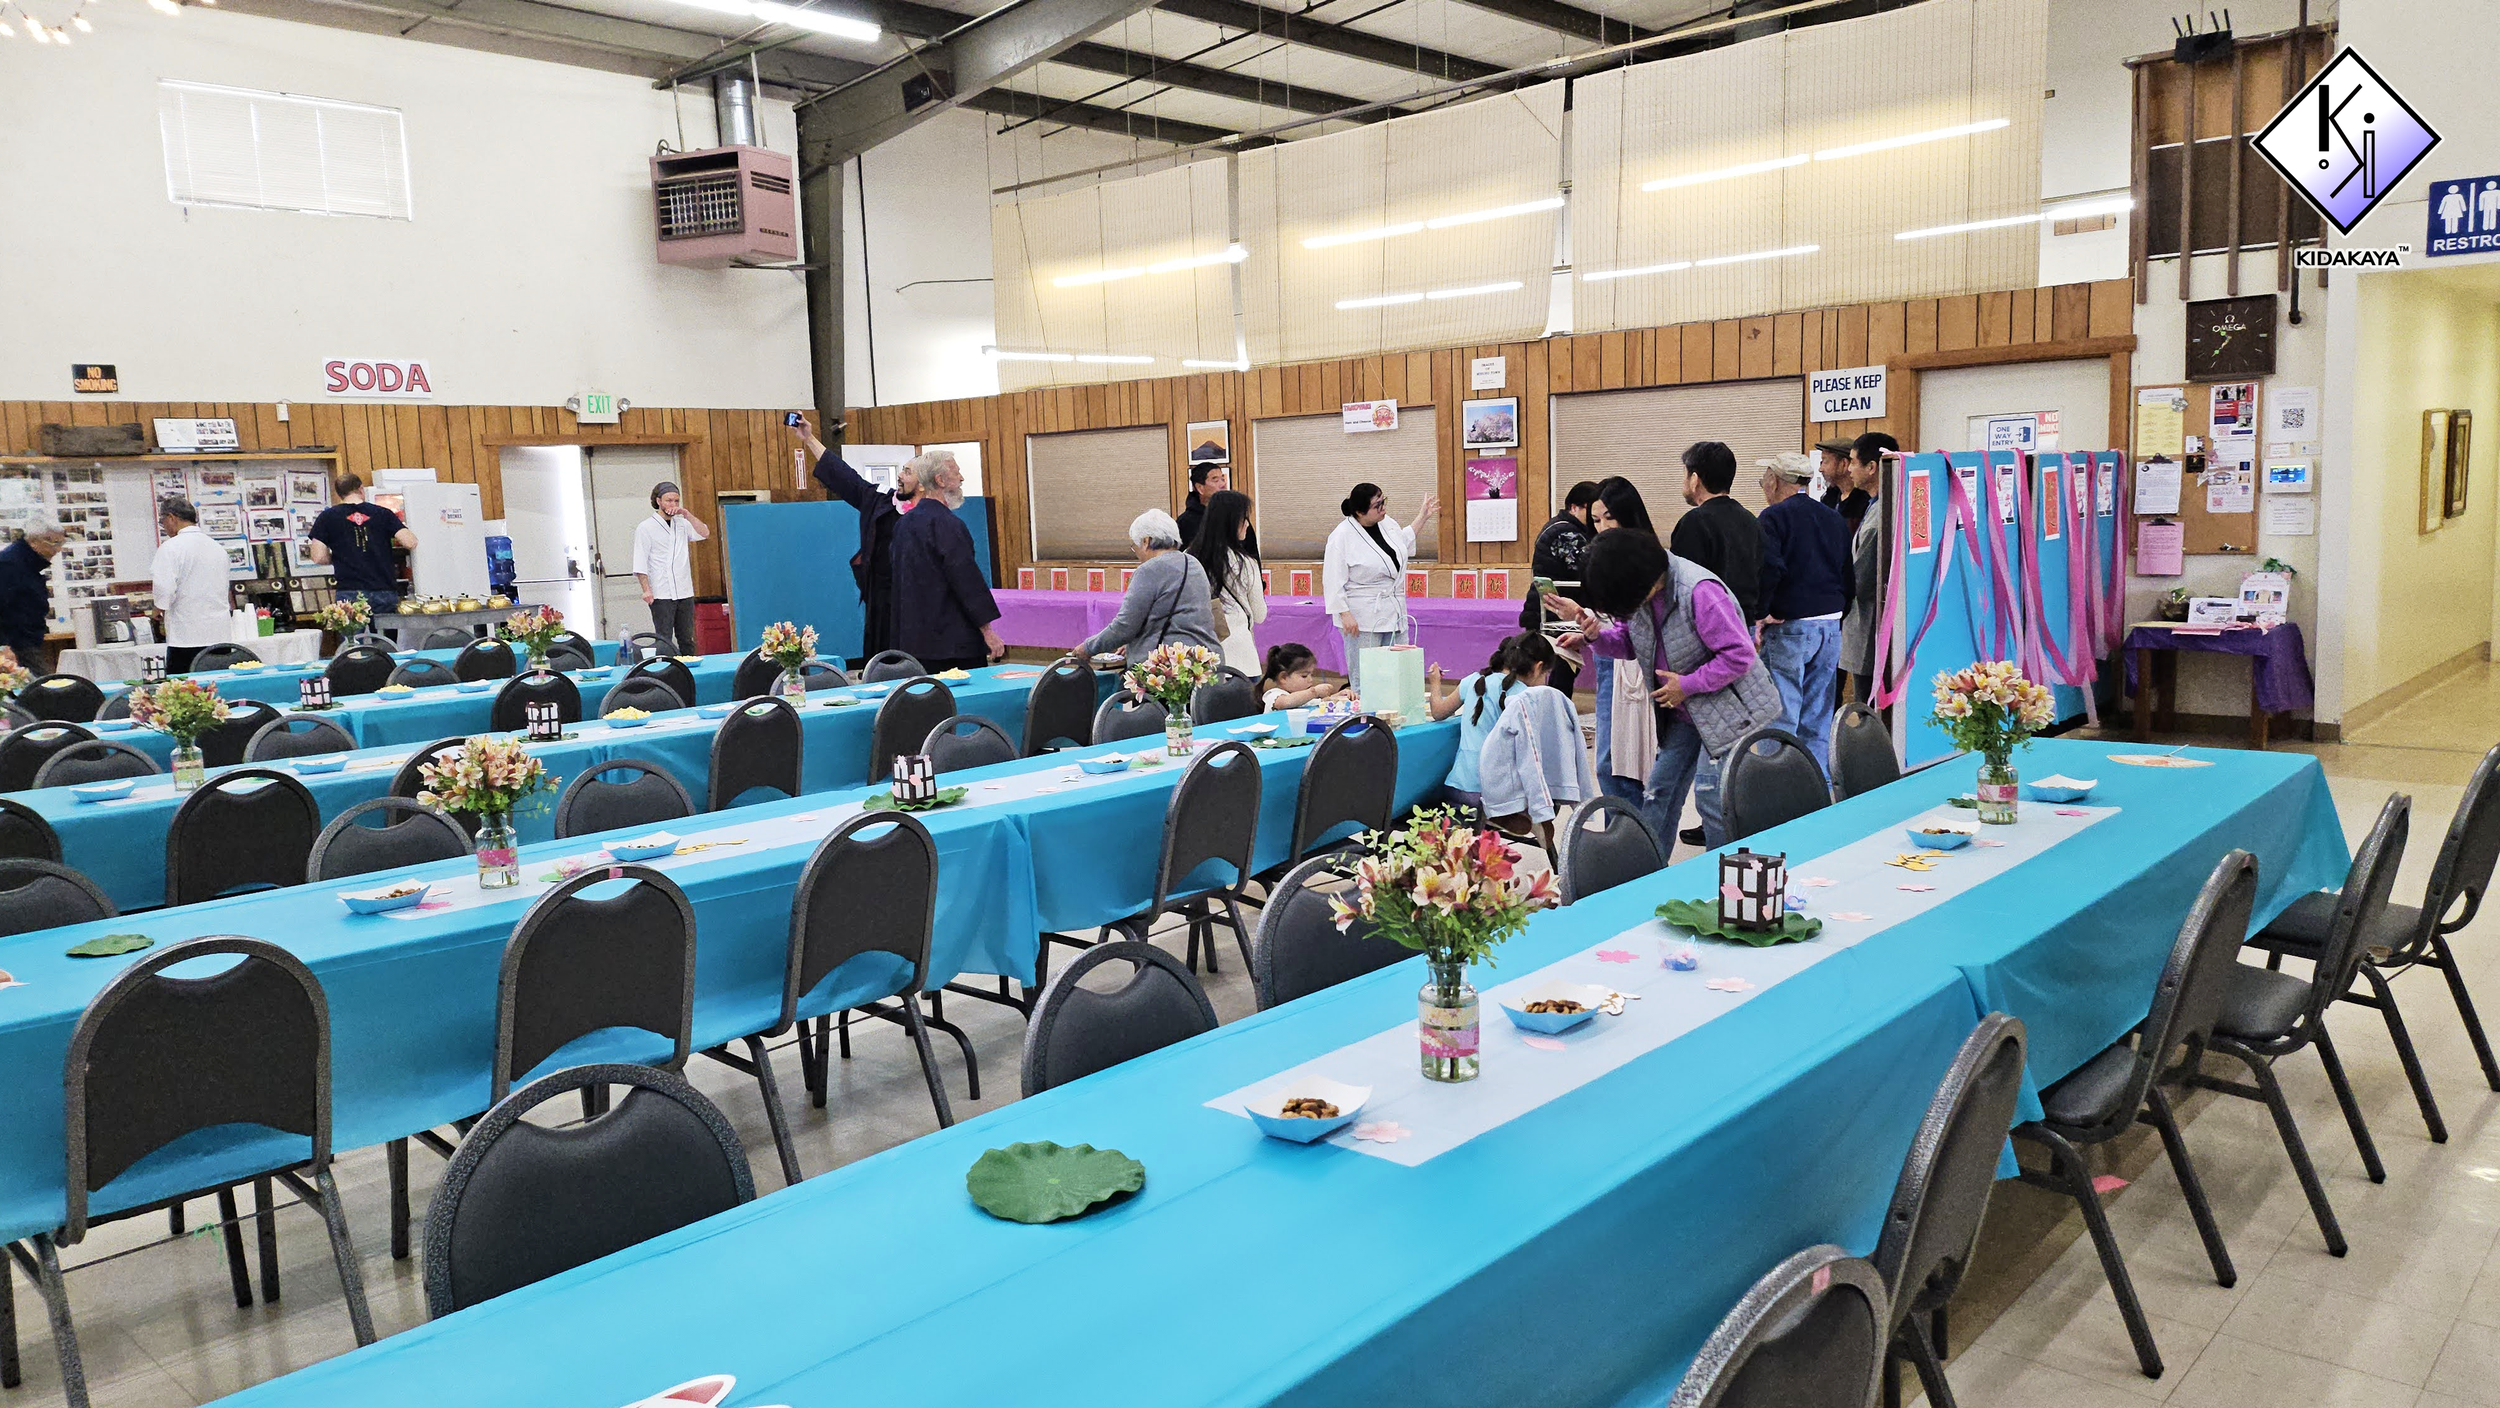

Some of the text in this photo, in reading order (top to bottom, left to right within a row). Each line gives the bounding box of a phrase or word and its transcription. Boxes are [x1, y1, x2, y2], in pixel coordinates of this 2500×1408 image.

[2212, 323, 2247, 333] OMEGA
[86, 366, 102, 379] NO
[325, 360, 432, 393] SODA
[74, 378, 118, 391] SMOKING
[1813, 374, 1882, 393] PLEASE KEEP
[587, 394, 611, 414] EXIT
[1824, 396, 1871, 413] CLEAN
[2044, 412, 2059, 423] NO
